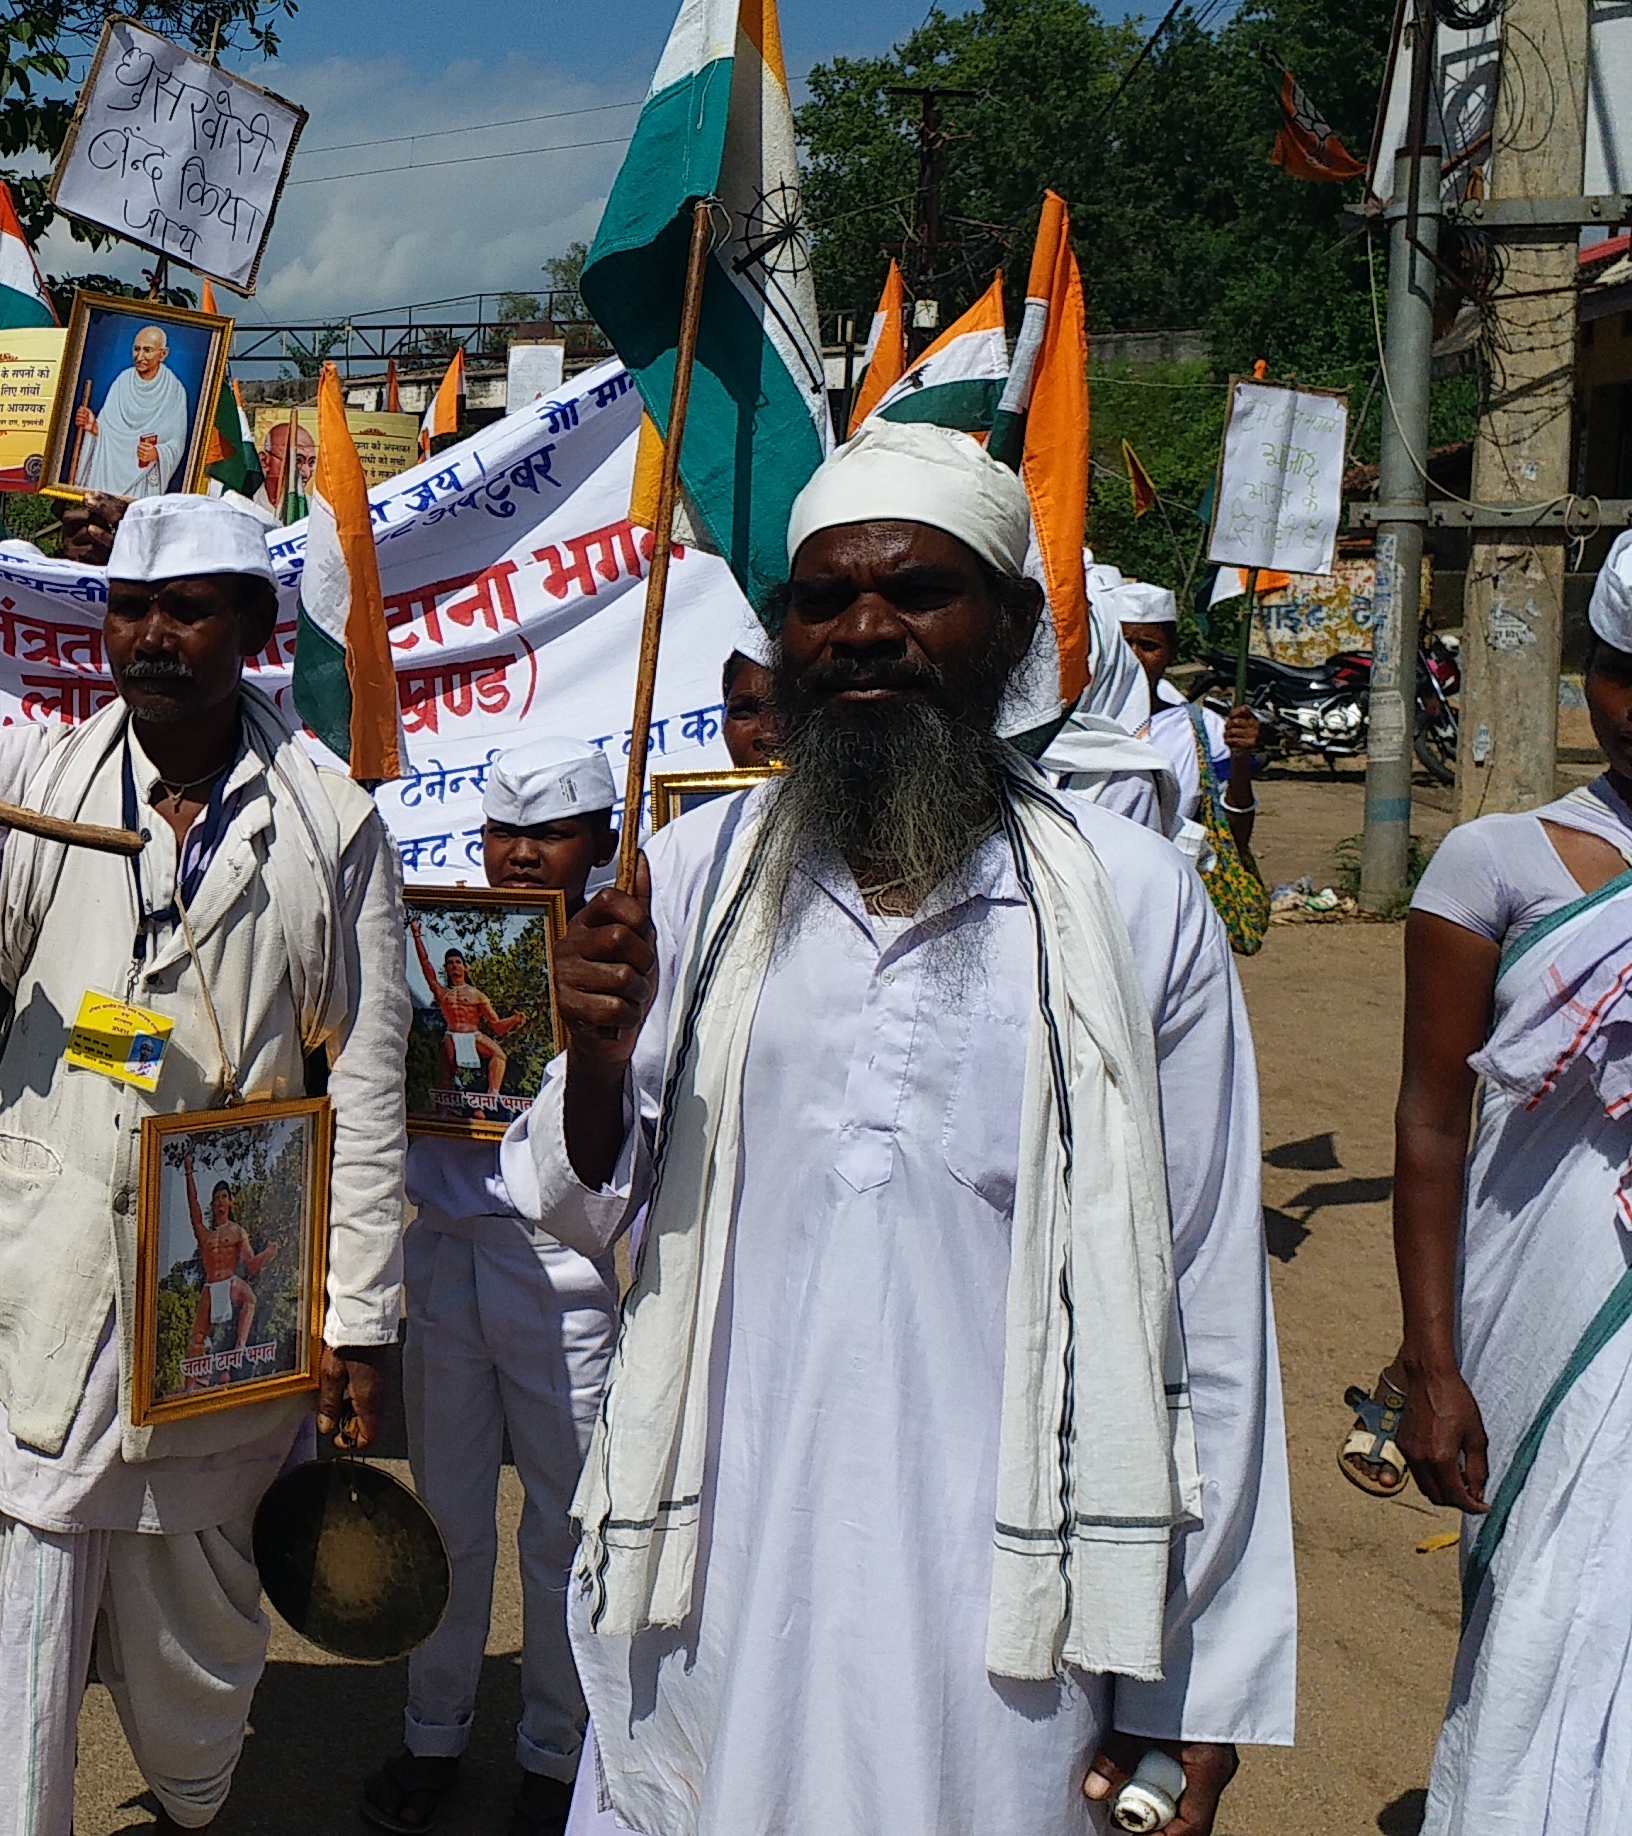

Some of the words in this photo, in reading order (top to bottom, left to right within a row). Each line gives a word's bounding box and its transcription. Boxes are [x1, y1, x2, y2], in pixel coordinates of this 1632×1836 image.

[179, 156, 264, 244] किया
[1, 366, 9, 378] के
[37, 366, 50, 379] को
[1, 383, 17, 397] लिए
[401, 461, 464, 513] जय
[467, 1091, 498, 1112] टाना
[180, 1354, 214, 1377] जतरा
[216, 1348, 243, 1371] टाना
[246, 1339, 277, 1364] भगत
